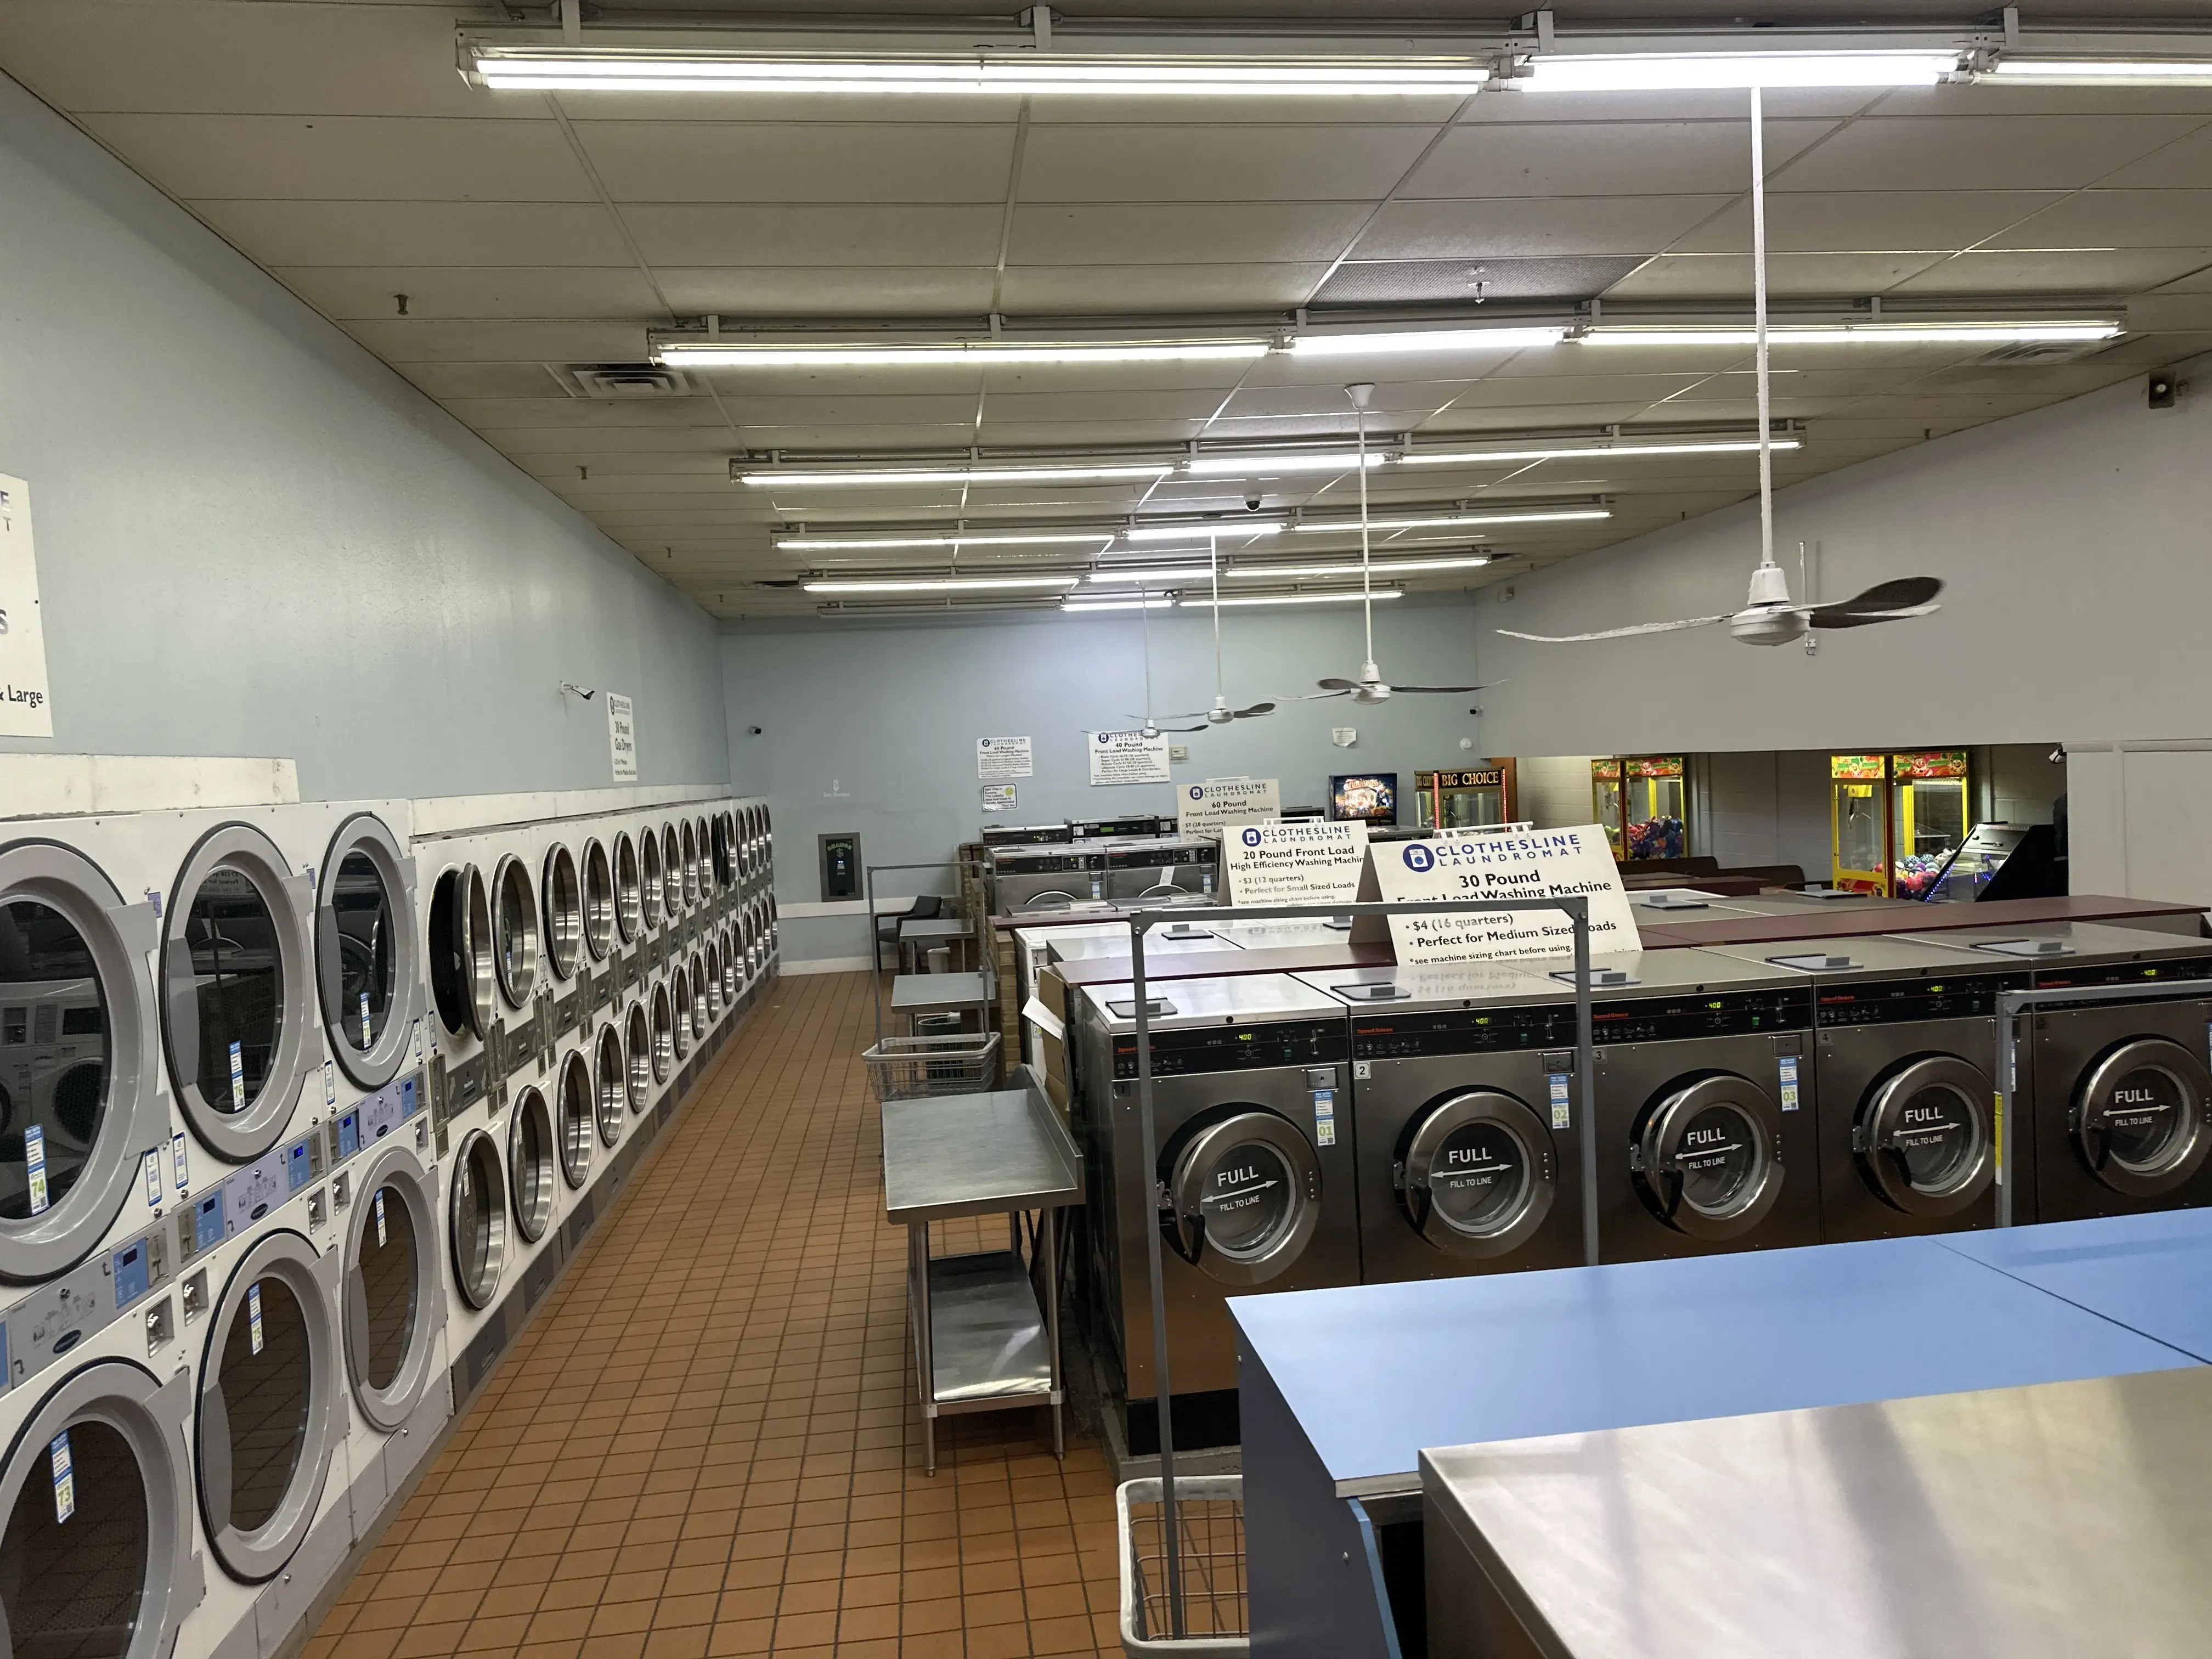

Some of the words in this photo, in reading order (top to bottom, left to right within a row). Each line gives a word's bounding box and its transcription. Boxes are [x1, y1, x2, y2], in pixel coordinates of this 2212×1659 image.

[8, 684, 43, 708] Large
[1442, 774, 1458, 786] BIG
[1462, 771, 1499, 785] CHOICE
[1205, 783, 1267, 793] CLOTHESLINE
[1263, 826, 1351, 837] CLOTHESLINE
[1264, 834, 1351, 843] LAUNDROMAT
[1243, 851, 1255, 860] 20
[1259, 849, 1292, 859] Pound
[1296, 848, 1325, 856] Front
[1328, 846, 1355, 855] Load
[1435, 834, 1580, 857] CLOTHESLINE
[1439, 846, 1582, 867] LAUNDROMAT
[1231, 862, 1251, 871] High
[1254, 860, 1294, 868] Efficiency
[1255, 877, 1266, 885] (12
[1269, 874, 1304, 884] quarters)
[1459, 874, 1480, 888] 30
[1485, 870, 1541, 886] Pound
[1480, 884, 1544, 899] Washing
[1549, 881, 1612, 895] Machine
[1413, 920, 1428, 932] $4
[1432, 918, 1452, 932] (16
[1455, 913, 1514, 930] quarters)
[1417, 935, 1463, 947] Perfect
[1465, 933, 1483, 943] for
[1486, 929, 1539, 941] Medium
[1588, 921, 1617, 932] oads
[1431, 953, 1467, 963] machine
[1468, 951, 1493, 960] sizing
[1494, 949, 1517, 957] chart
[1519, 946, 1547, 955] before
[1549, 944, 1573, 952] using.
[1822, 1034, 1829, 1042] 4
[1596, 1051, 1602, 1060] 3
[1359, 1066, 1365, 1075] 2
[234, 1084, 243, 1098] 76
[1783, 1091, 1796, 1101] 03
[2115, 1088, 2154, 1104] FULL
[1554, 1109, 1567, 1120] 02
[1905, 1107, 1944, 1123] FULL
[2139, 1116, 2153, 1124] LINE
[1318, 1126, 1333, 1137] 01
[1687, 1127, 1726, 1146] FULL
[1905, 1139, 1920, 1147] FILL
[1920, 1137, 1928, 1145] TO
[1929, 1135, 1943, 1143] LINE
[1448, 1147, 1492, 1164] FULL
[1689, 1161, 1702, 1170] FILL
[1712, 1156, 1725, 1166] LINE
[1217, 1166, 1259, 1187] FULL
[1477, 1176, 1492, 1186] LINE
[31, 1178, 45, 1198] 74
[1220, 1203, 1234, 1212] FILL
[1235, 1200, 1244, 1208] TO
[1245, 1195, 1260, 1206] LINE
[253, 1327, 261, 1342] 75
[58, 1486, 71, 1506] 73
